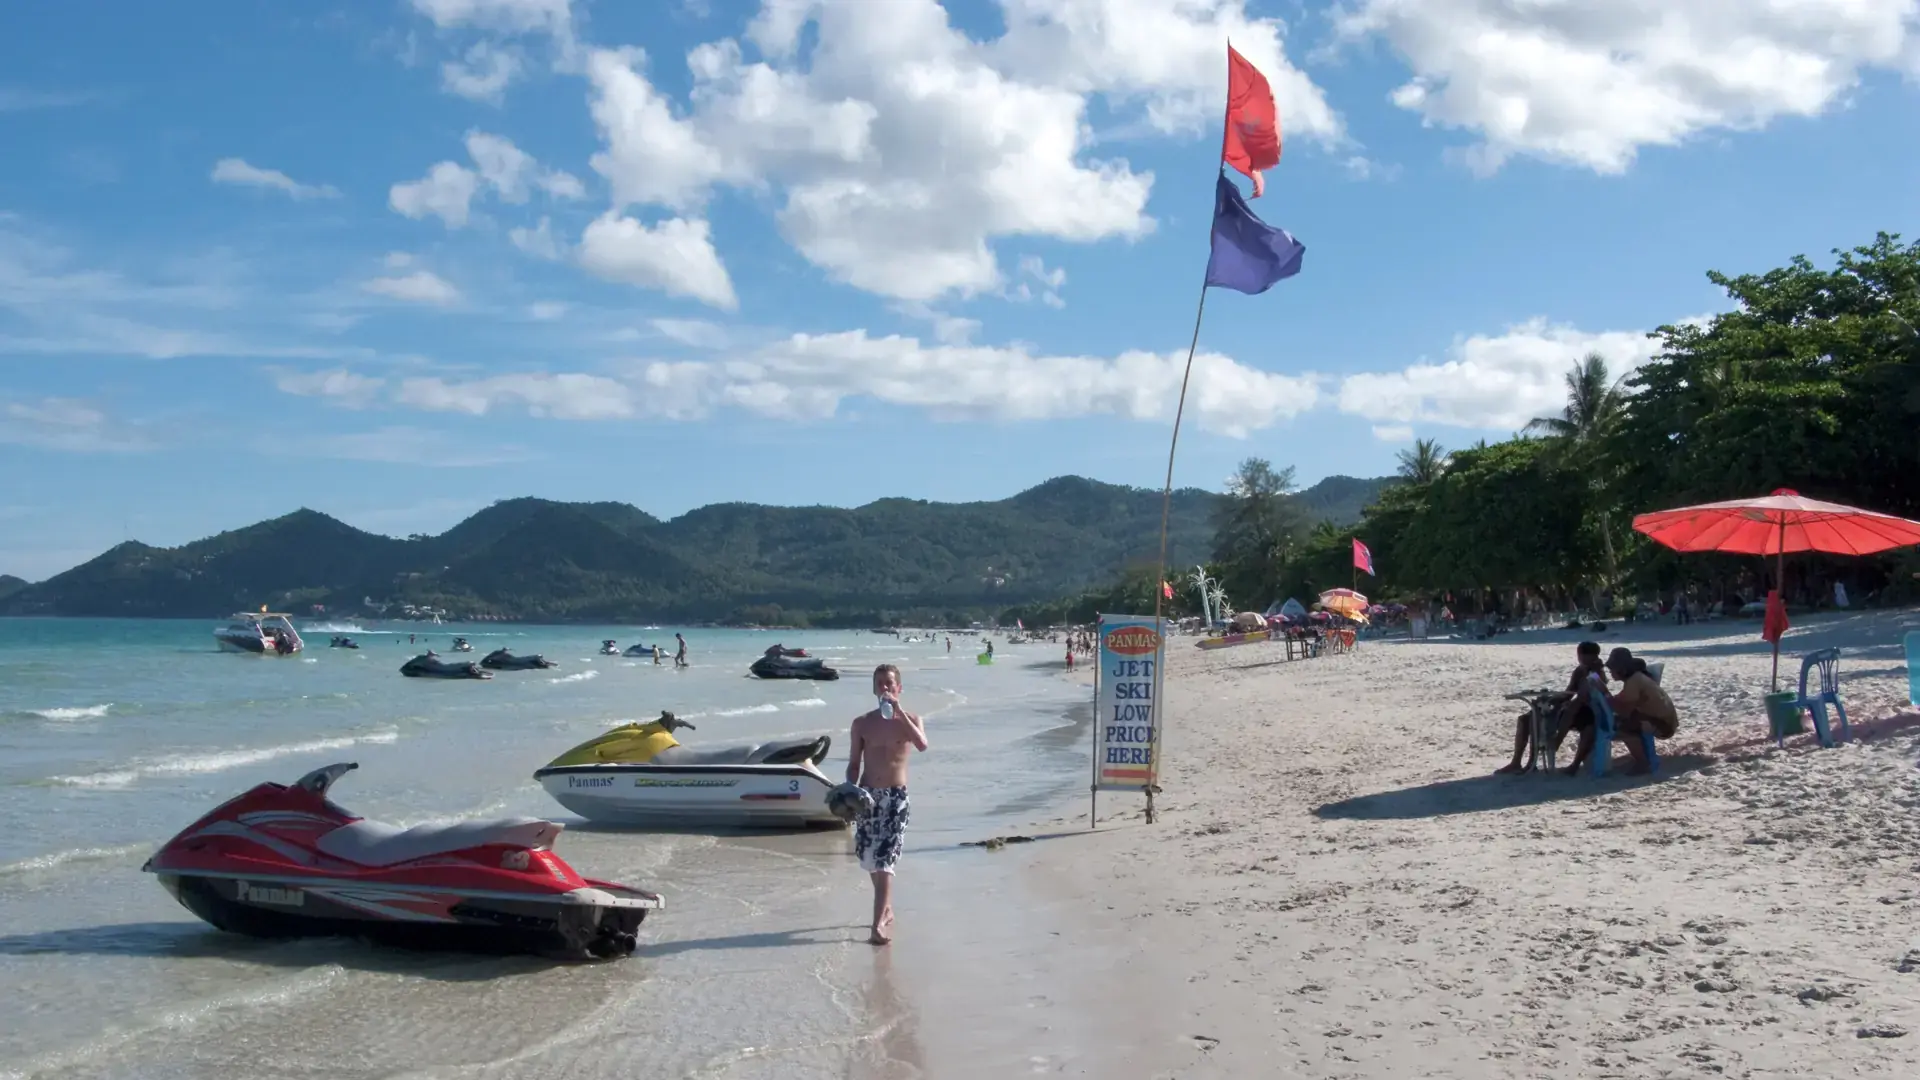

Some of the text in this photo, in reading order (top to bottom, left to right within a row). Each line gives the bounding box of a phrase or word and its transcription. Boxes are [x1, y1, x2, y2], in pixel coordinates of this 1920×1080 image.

[1107, 633, 1157, 648] PANMAS
[1112, 660, 1154, 677] JET
[1115, 682, 1151, 699] SKI
[1113, 704, 1151, 721] LOW
[1105, 726, 1157, 743] PRICE
[1106, 747, 1155, 764] HERE
[788, 779, 799, 792] 3
